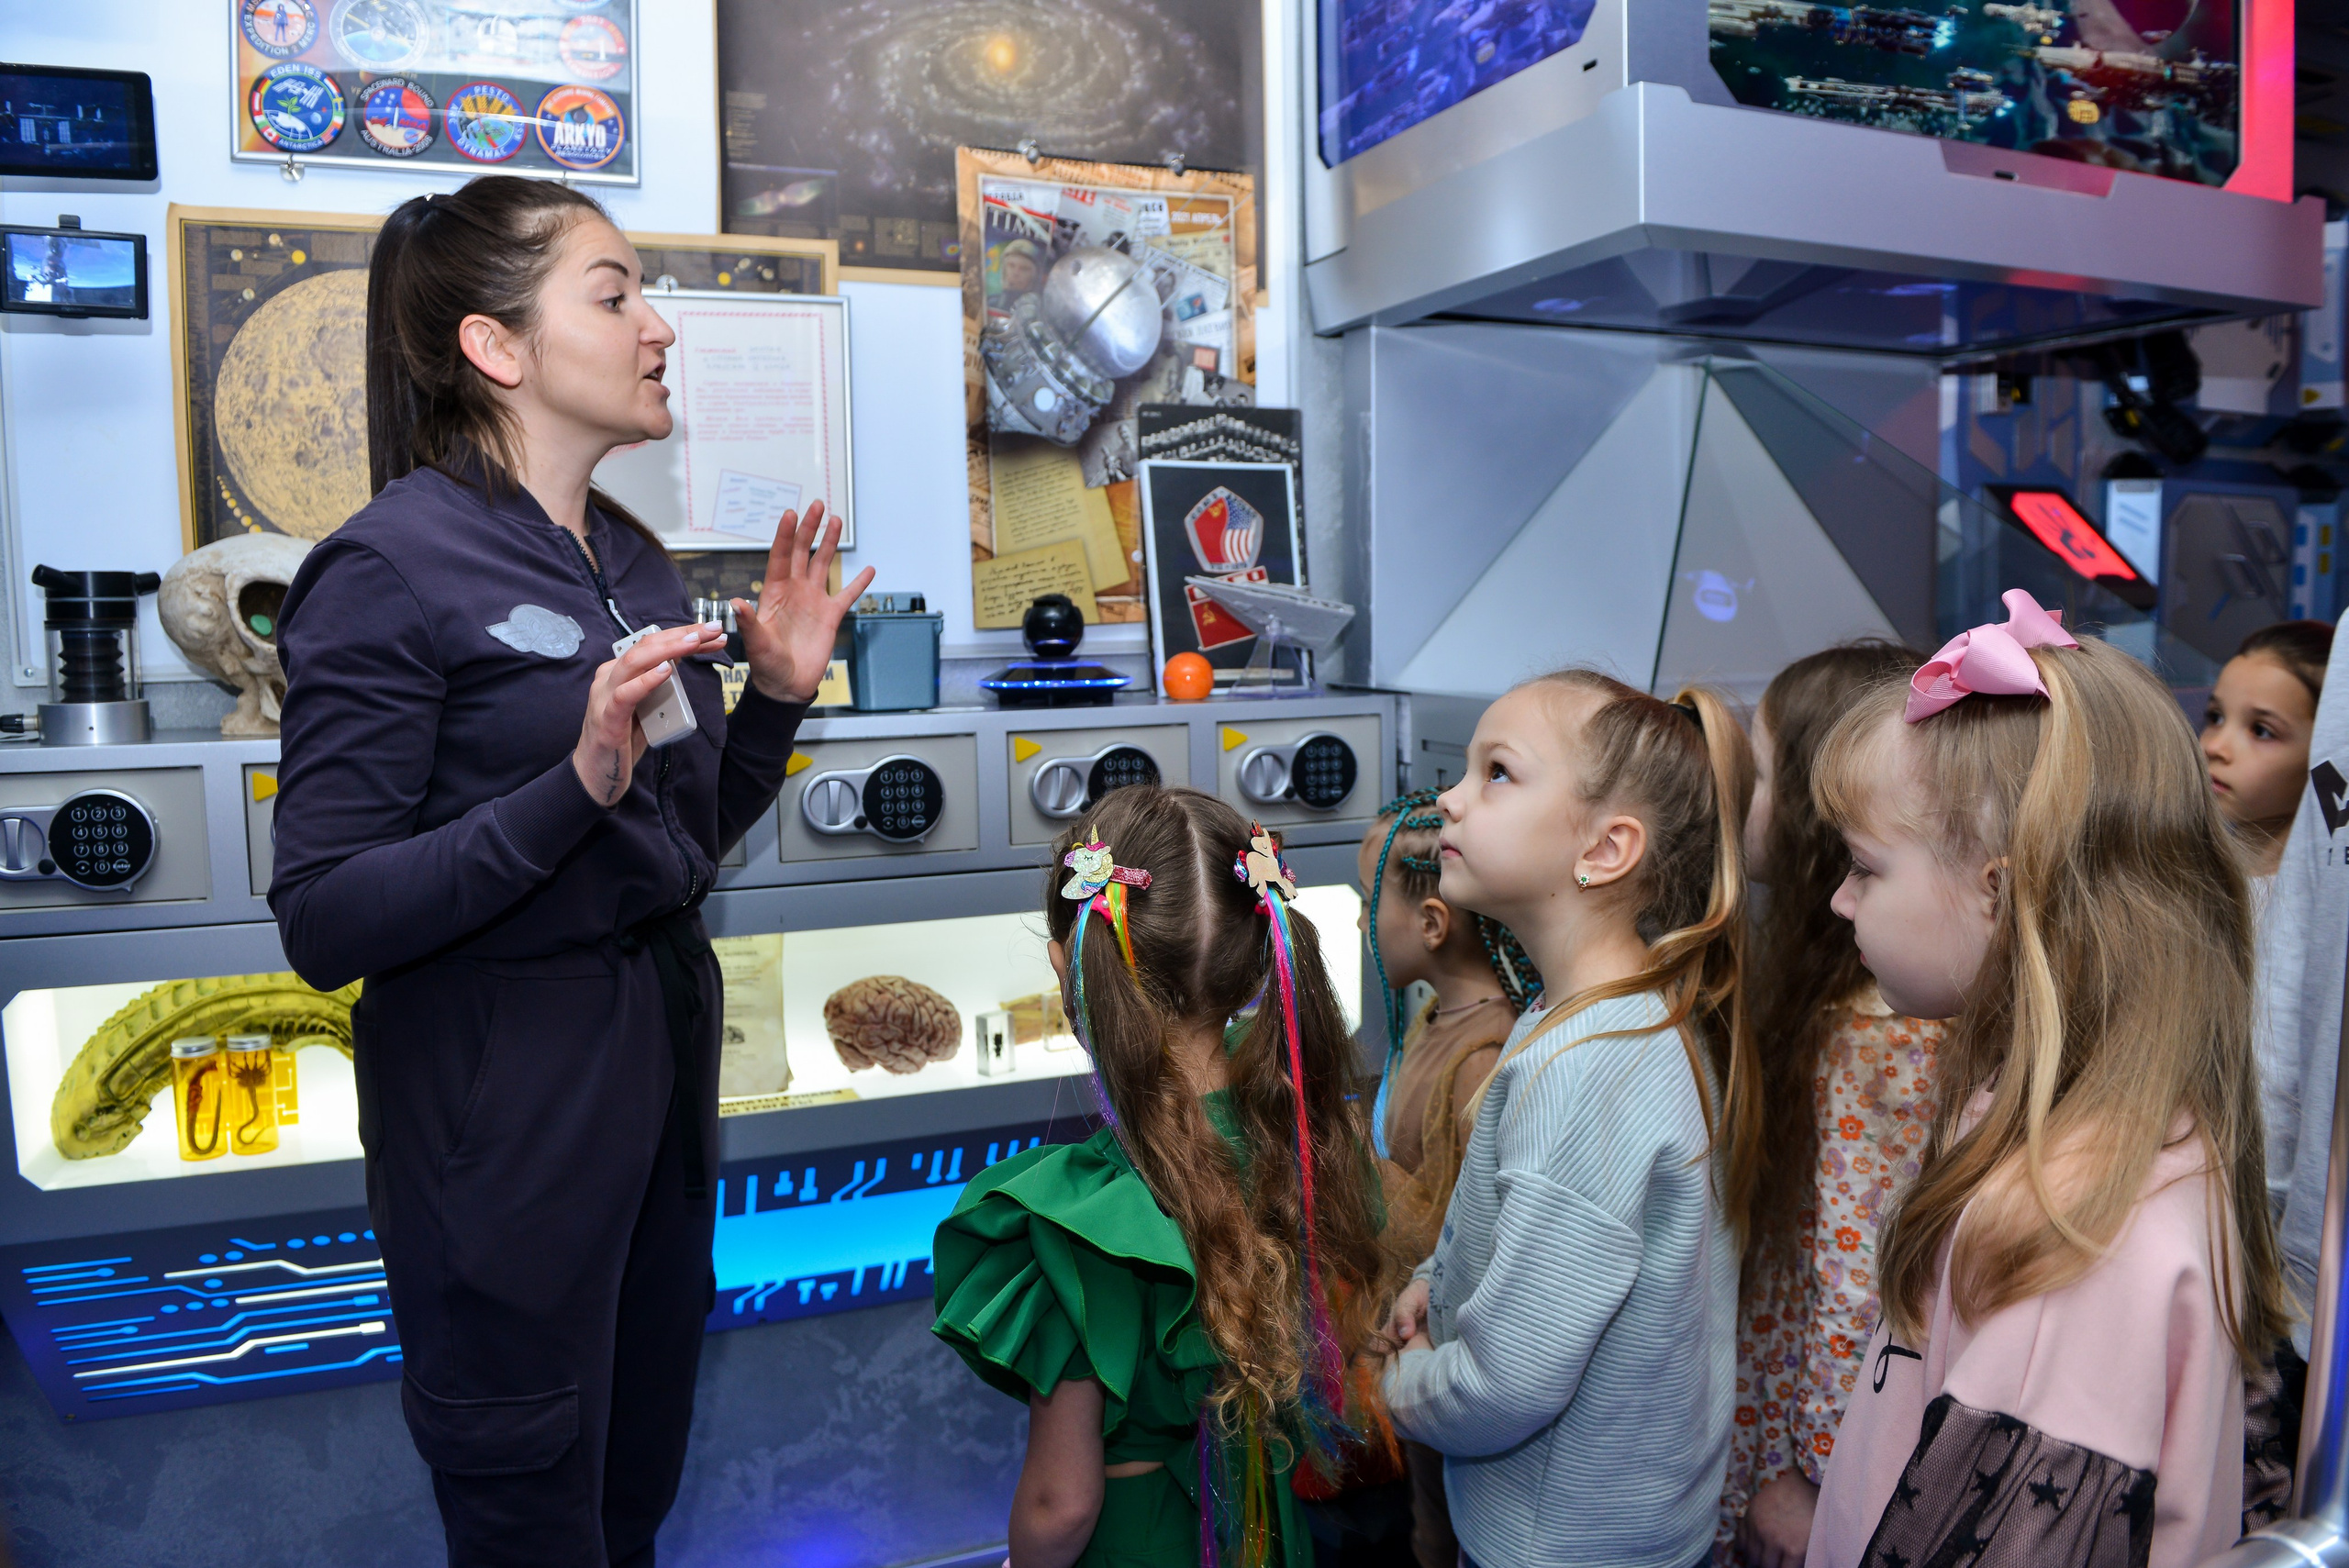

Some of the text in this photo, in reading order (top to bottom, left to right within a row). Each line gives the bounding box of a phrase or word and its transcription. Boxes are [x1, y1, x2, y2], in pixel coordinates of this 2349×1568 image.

[271, 63, 300, 79] EDEN
[406, 82, 435, 108] BOUND
[473, 84, 511, 103] PESTO
[552, 120, 607, 149] ARKYD
